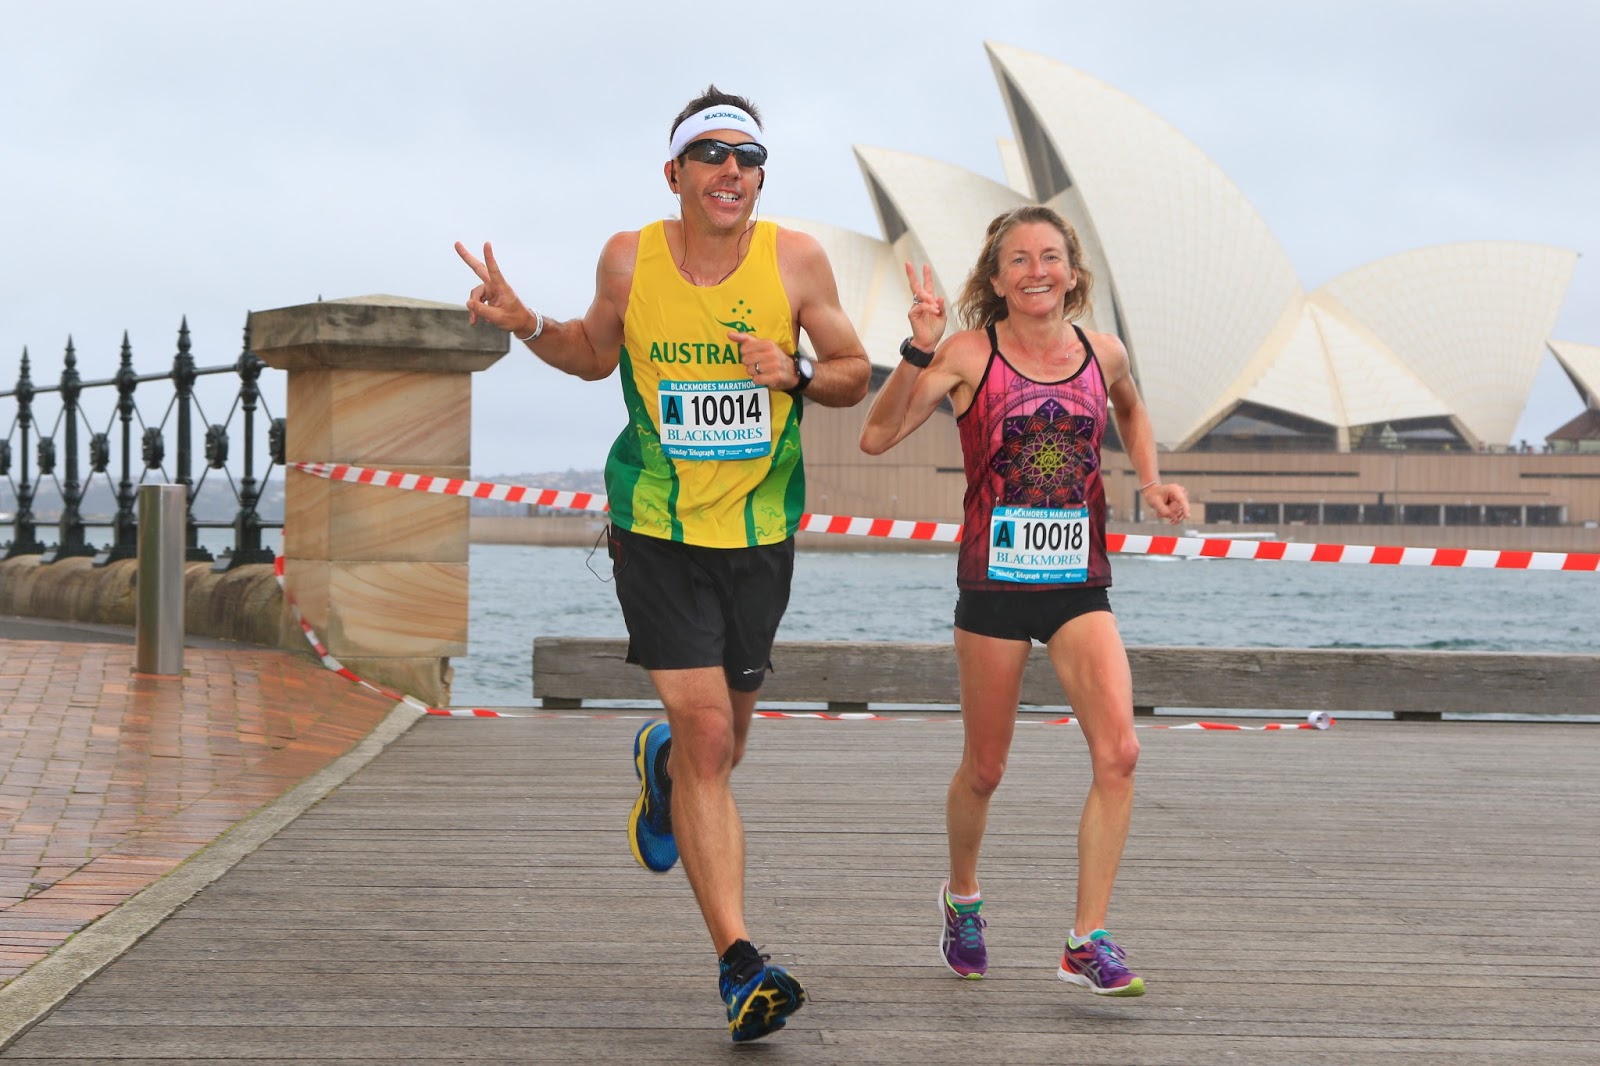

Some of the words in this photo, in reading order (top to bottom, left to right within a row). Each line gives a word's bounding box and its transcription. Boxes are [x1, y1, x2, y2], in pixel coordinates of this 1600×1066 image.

[650, 341, 743, 364] AUSTRA
[670, 382, 716, 391] BLACKMORES
[718, 381, 756, 391] MARATHON
[666, 396, 680, 424] A
[691, 393, 762, 426] 10014
[667, 427, 763, 441] BLACKMORES
[1005, 509, 1048, 518] BLACKMORES
[1049, 510, 1082, 519] MARATHON
[995, 521, 1011, 548] A
[1023, 522, 1083, 551] 10018
[996, 552, 1082, 565] BLACKMORES
